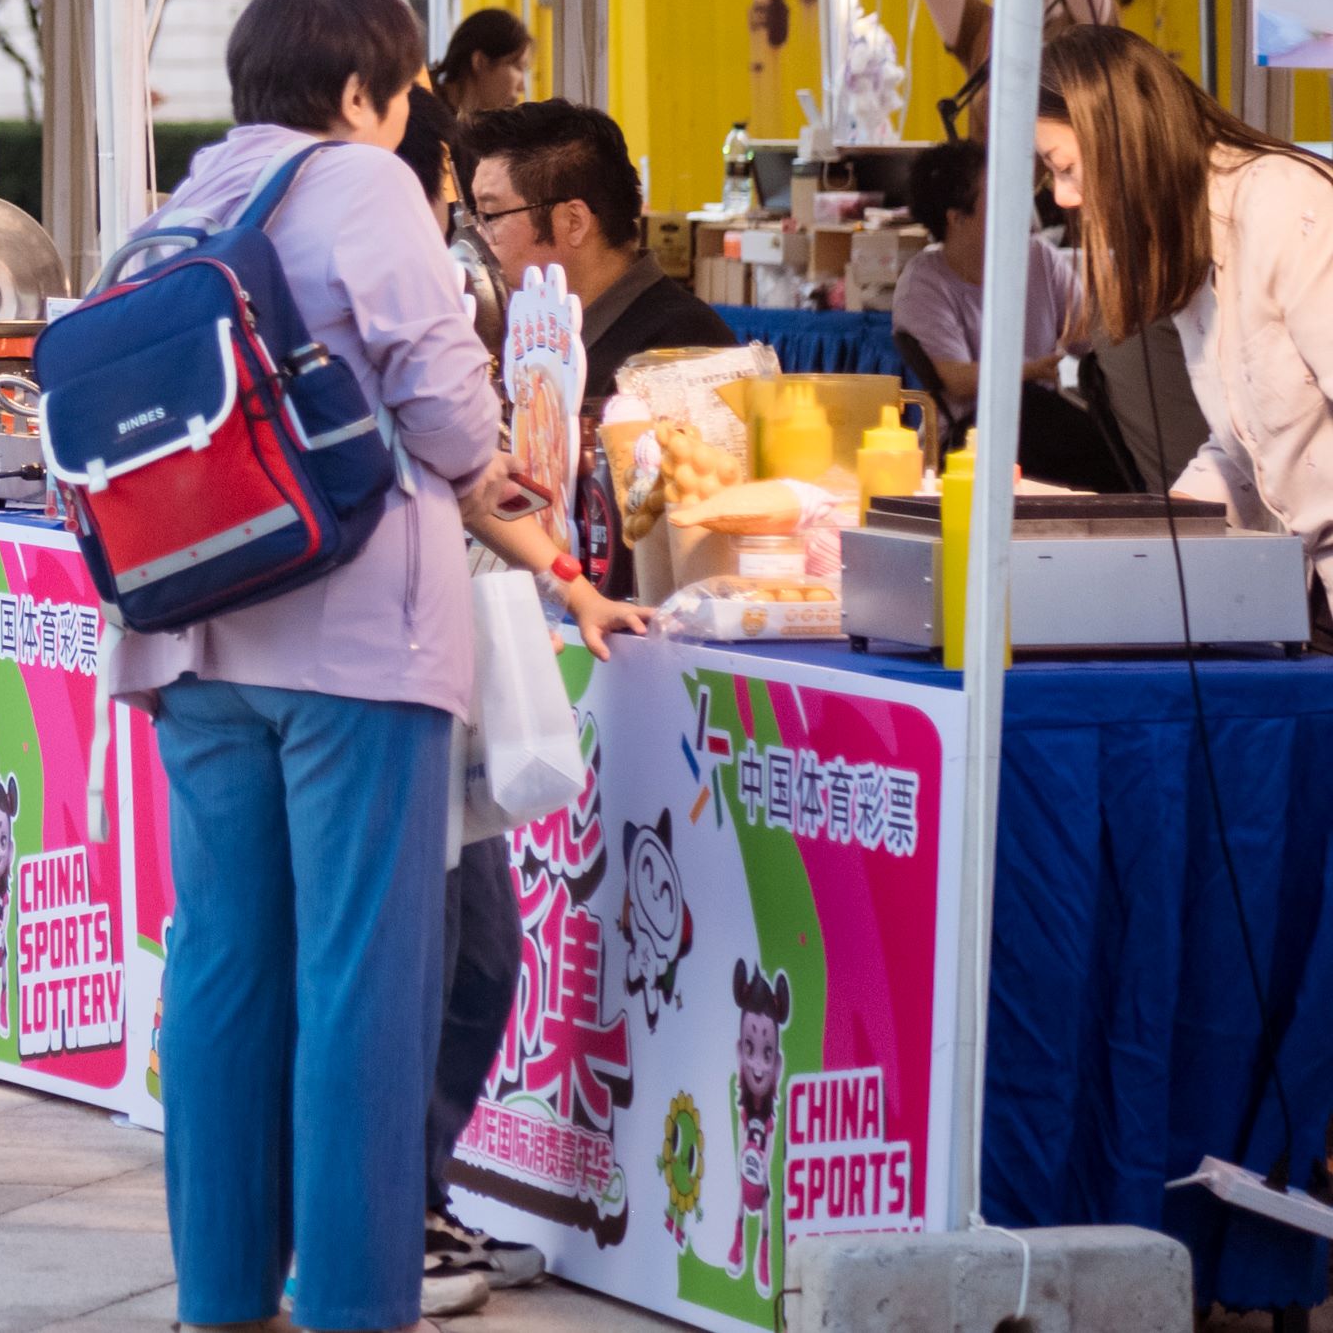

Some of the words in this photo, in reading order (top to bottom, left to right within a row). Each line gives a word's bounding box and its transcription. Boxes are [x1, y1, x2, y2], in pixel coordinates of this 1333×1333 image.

[117, 407, 166, 436] BINBES
[741, 749, 916, 852] 中国体育彩票
[21, 853, 86, 913] CHINA
[21, 912, 108, 972] SPORTS
[21, 972, 122, 1034] LOTTERY
[789, 1078, 880, 1143] CHINA
[789, 1153, 907, 1218] SPORTS
